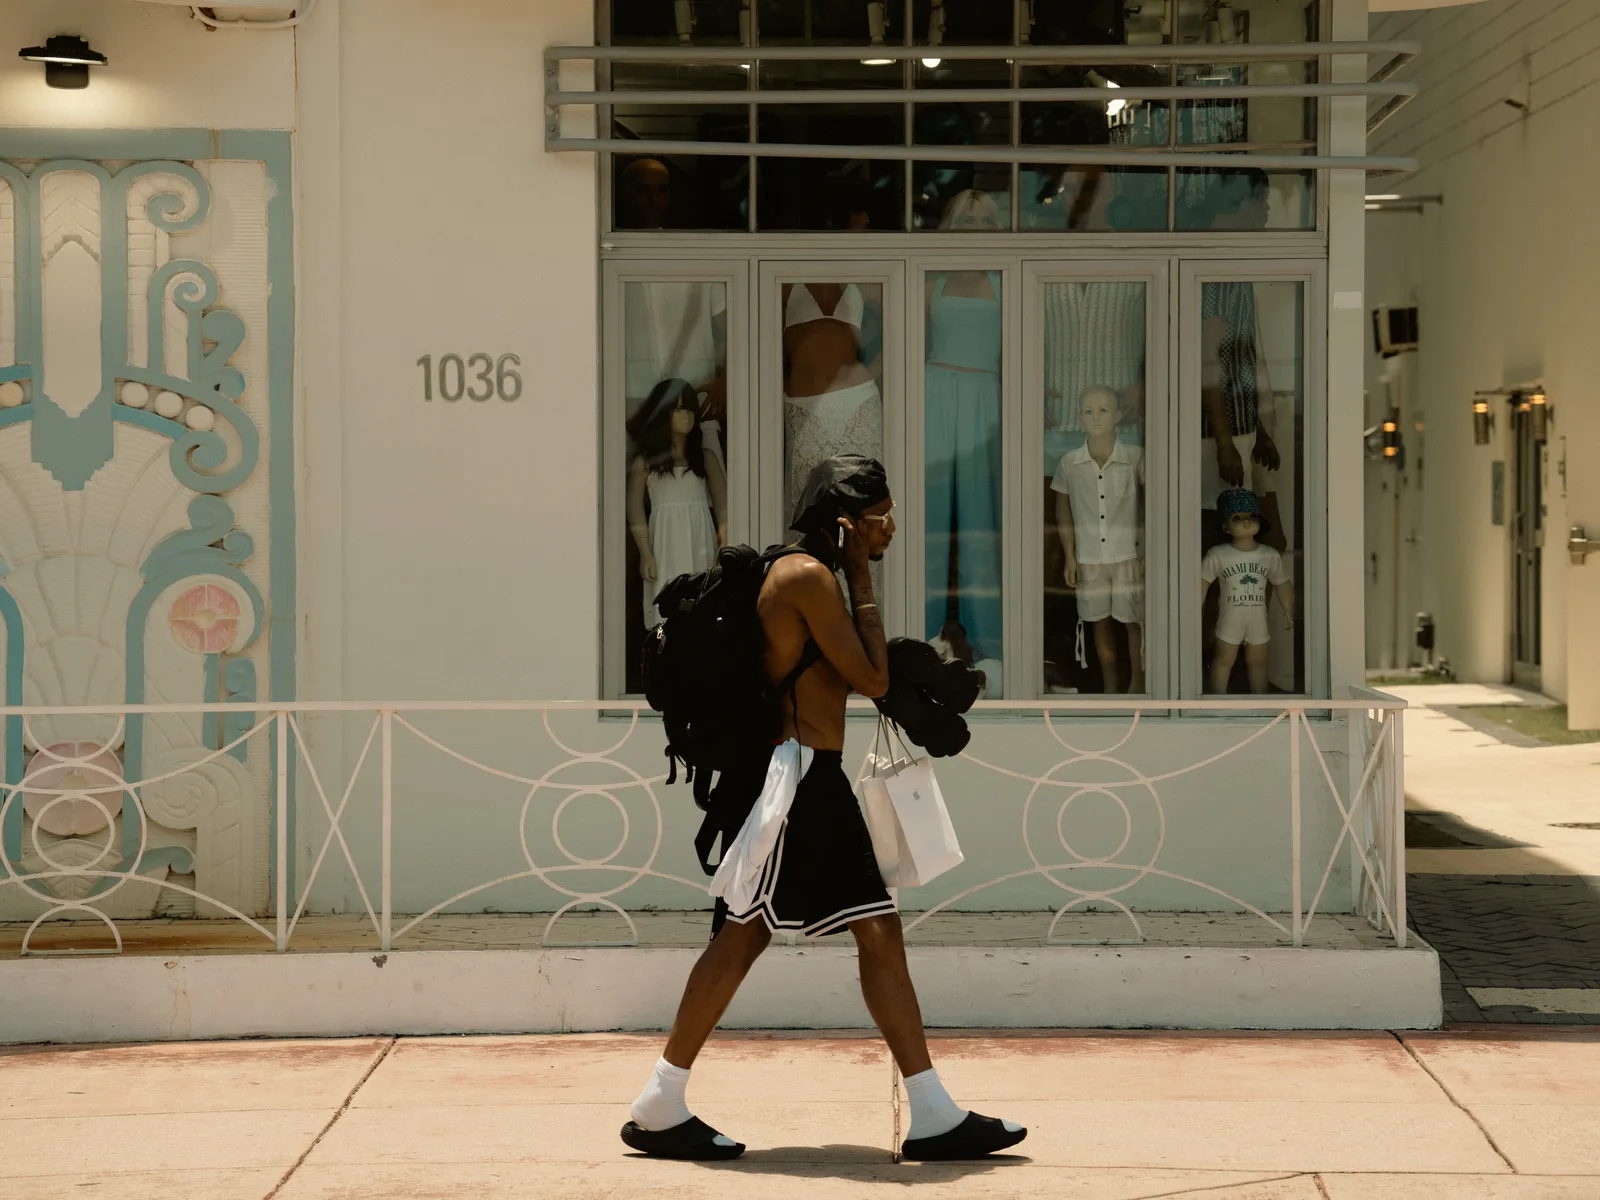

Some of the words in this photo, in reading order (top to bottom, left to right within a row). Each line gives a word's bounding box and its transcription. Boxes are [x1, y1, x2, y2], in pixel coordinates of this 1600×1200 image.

[416, 352, 522, 402] 1036
[1221, 562, 1247, 579] MIAMI
[1249, 562, 1270, 578] BEAC
[1227, 594, 1264, 602] FLORID
